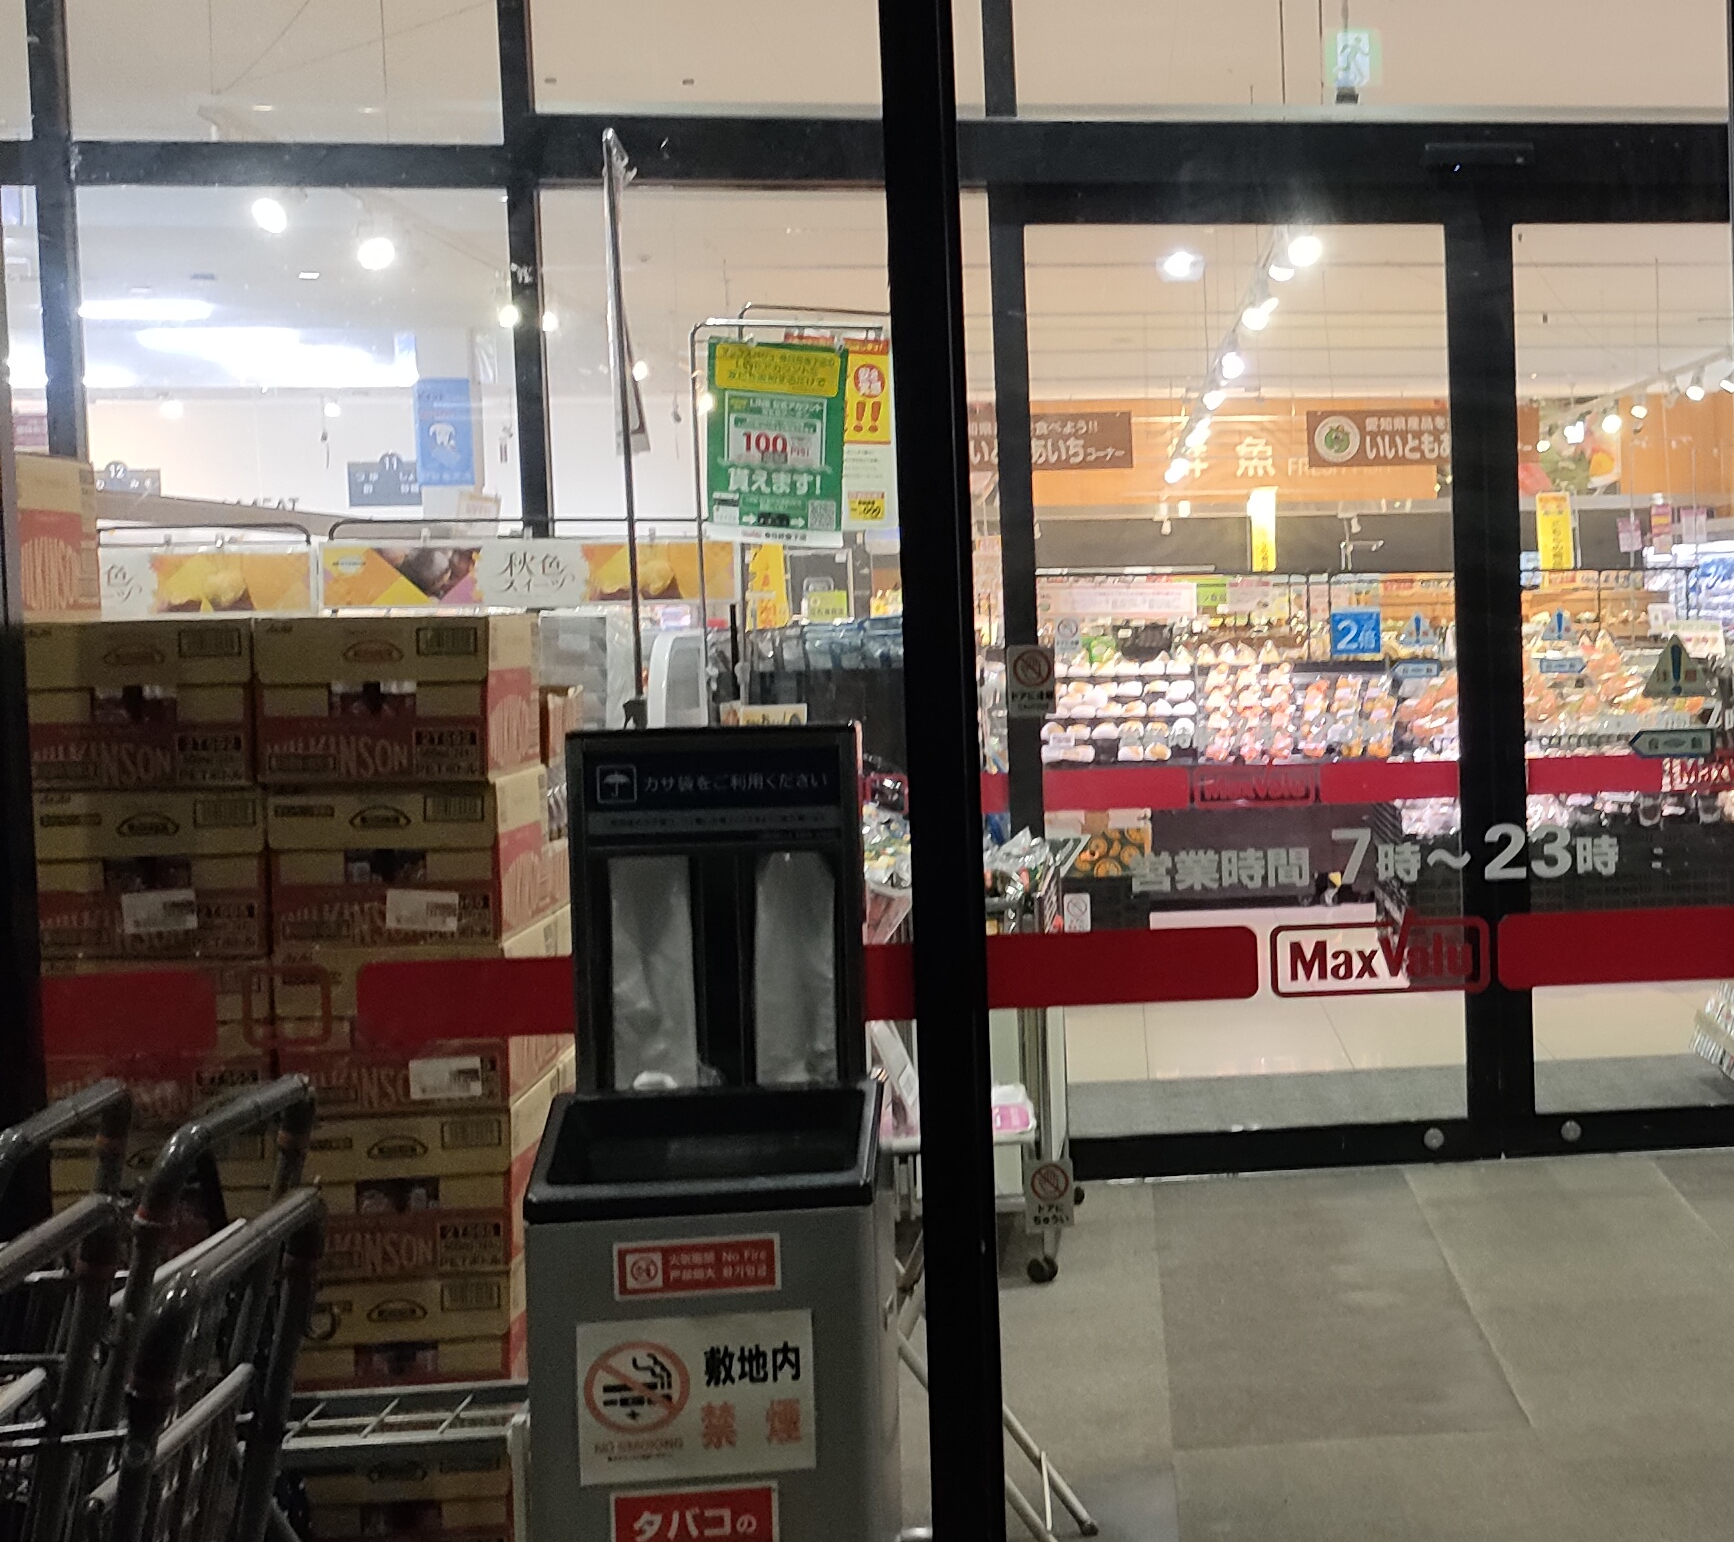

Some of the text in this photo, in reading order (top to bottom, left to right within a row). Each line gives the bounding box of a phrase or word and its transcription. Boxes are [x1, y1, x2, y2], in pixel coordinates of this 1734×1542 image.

[743, 430, 788, 454] 100
[1130, 846, 1310, 894] 営業時間
[1289, 908, 1474, 983] MaxValu
[721, 1251, 740, 1263] No
[703, 1340, 801, 1388] 敷地内
[700, 1398, 803, 1451] 禁煙
